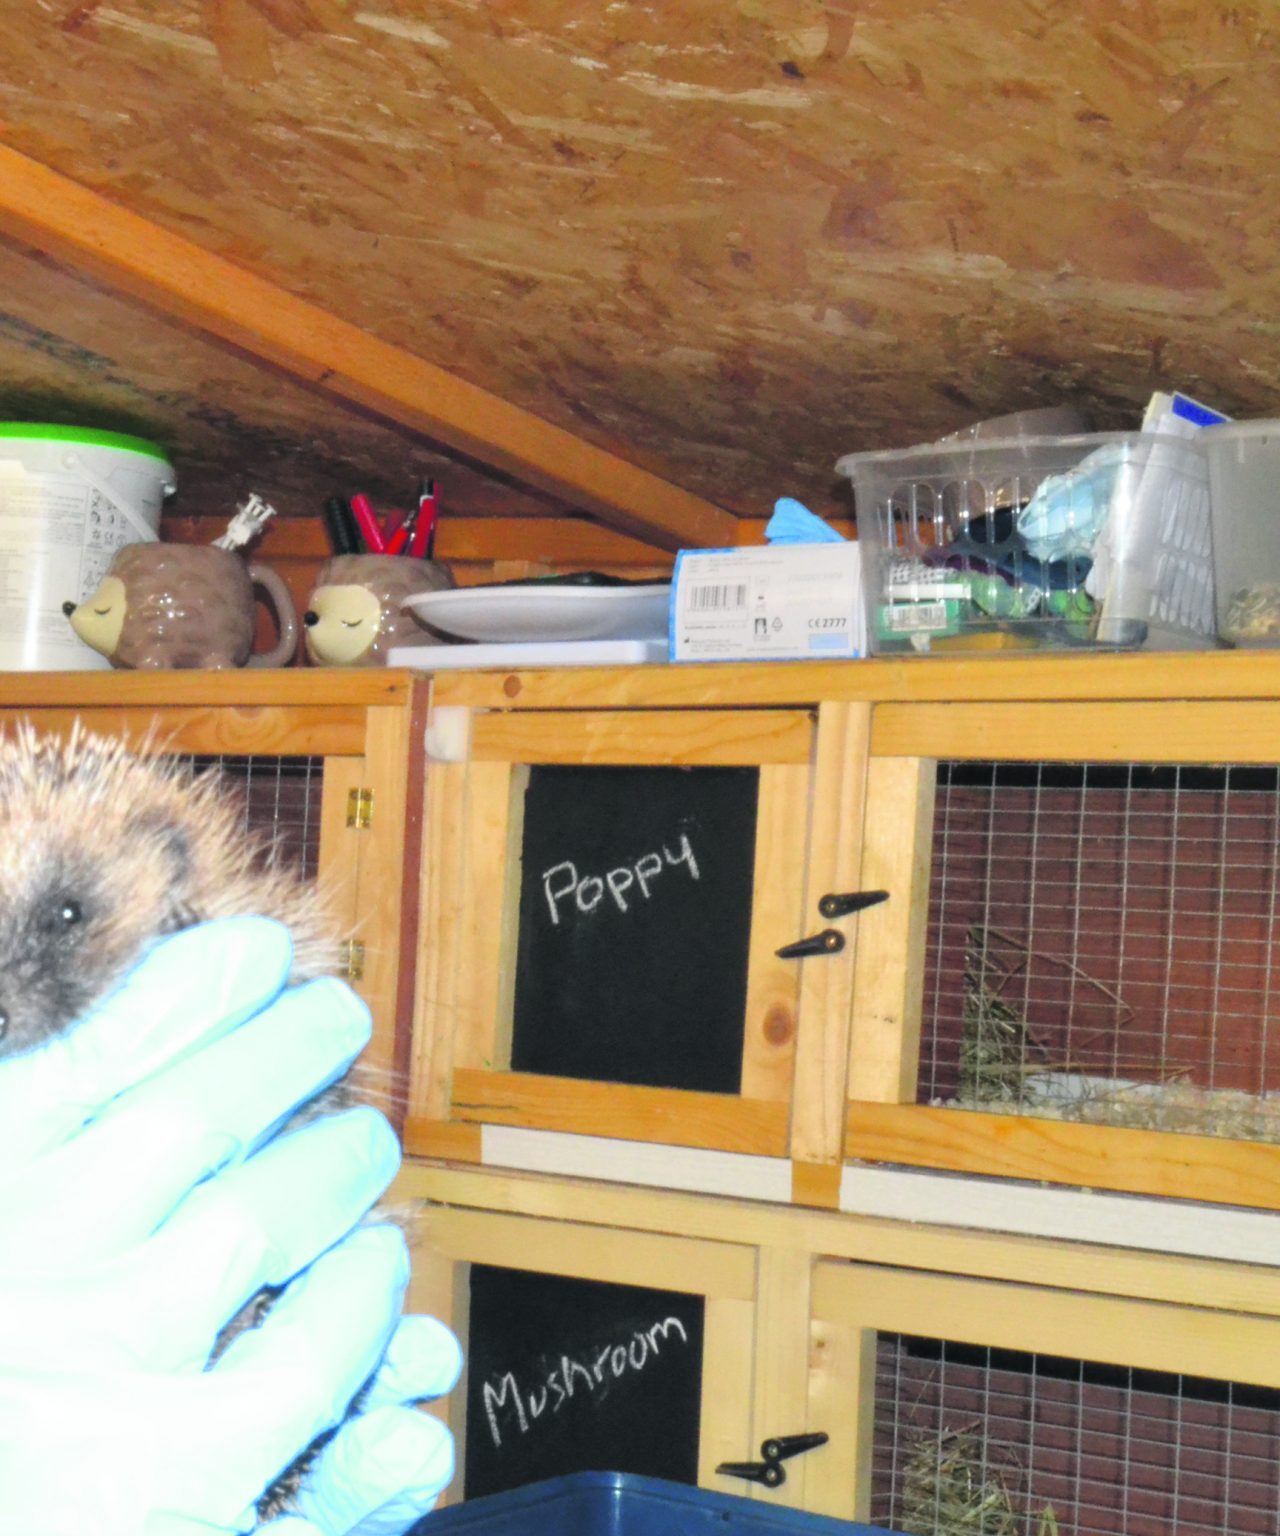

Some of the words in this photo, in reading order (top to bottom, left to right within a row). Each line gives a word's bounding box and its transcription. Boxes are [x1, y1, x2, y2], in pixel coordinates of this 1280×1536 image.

[822, 617, 848, 629] 2777
[542, 833, 700, 925] Poppy
[483, 1317, 687, 1447] Mushroom
